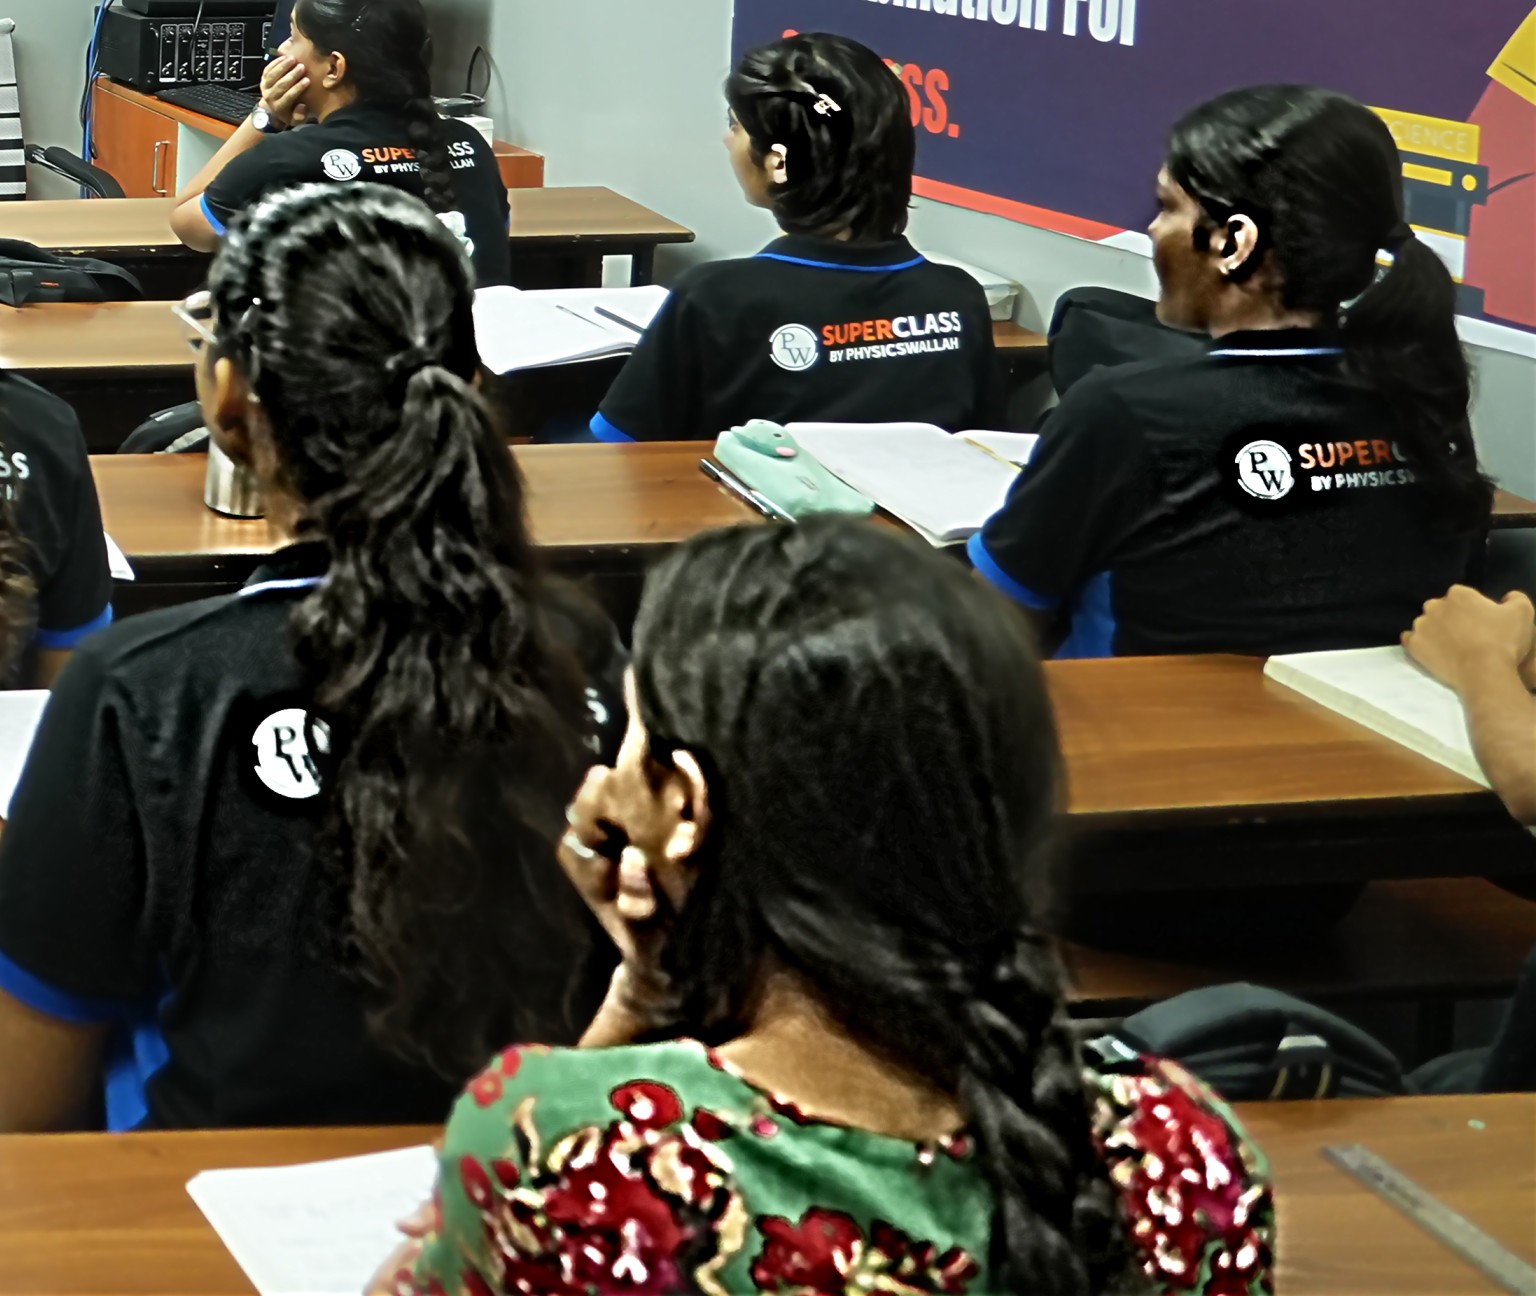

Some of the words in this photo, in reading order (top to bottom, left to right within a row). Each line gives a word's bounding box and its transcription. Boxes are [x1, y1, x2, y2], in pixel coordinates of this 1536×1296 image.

[1388, 120, 1469, 153] CIENCE
[373, 164, 389, 174] BY
[822, 311, 961, 346] SUPERCLASS
[829, 349, 844, 363] BY
[846, 337, 959, 361] PHYSICSWALLAH
[1311, 474, 1332, 492] BY
